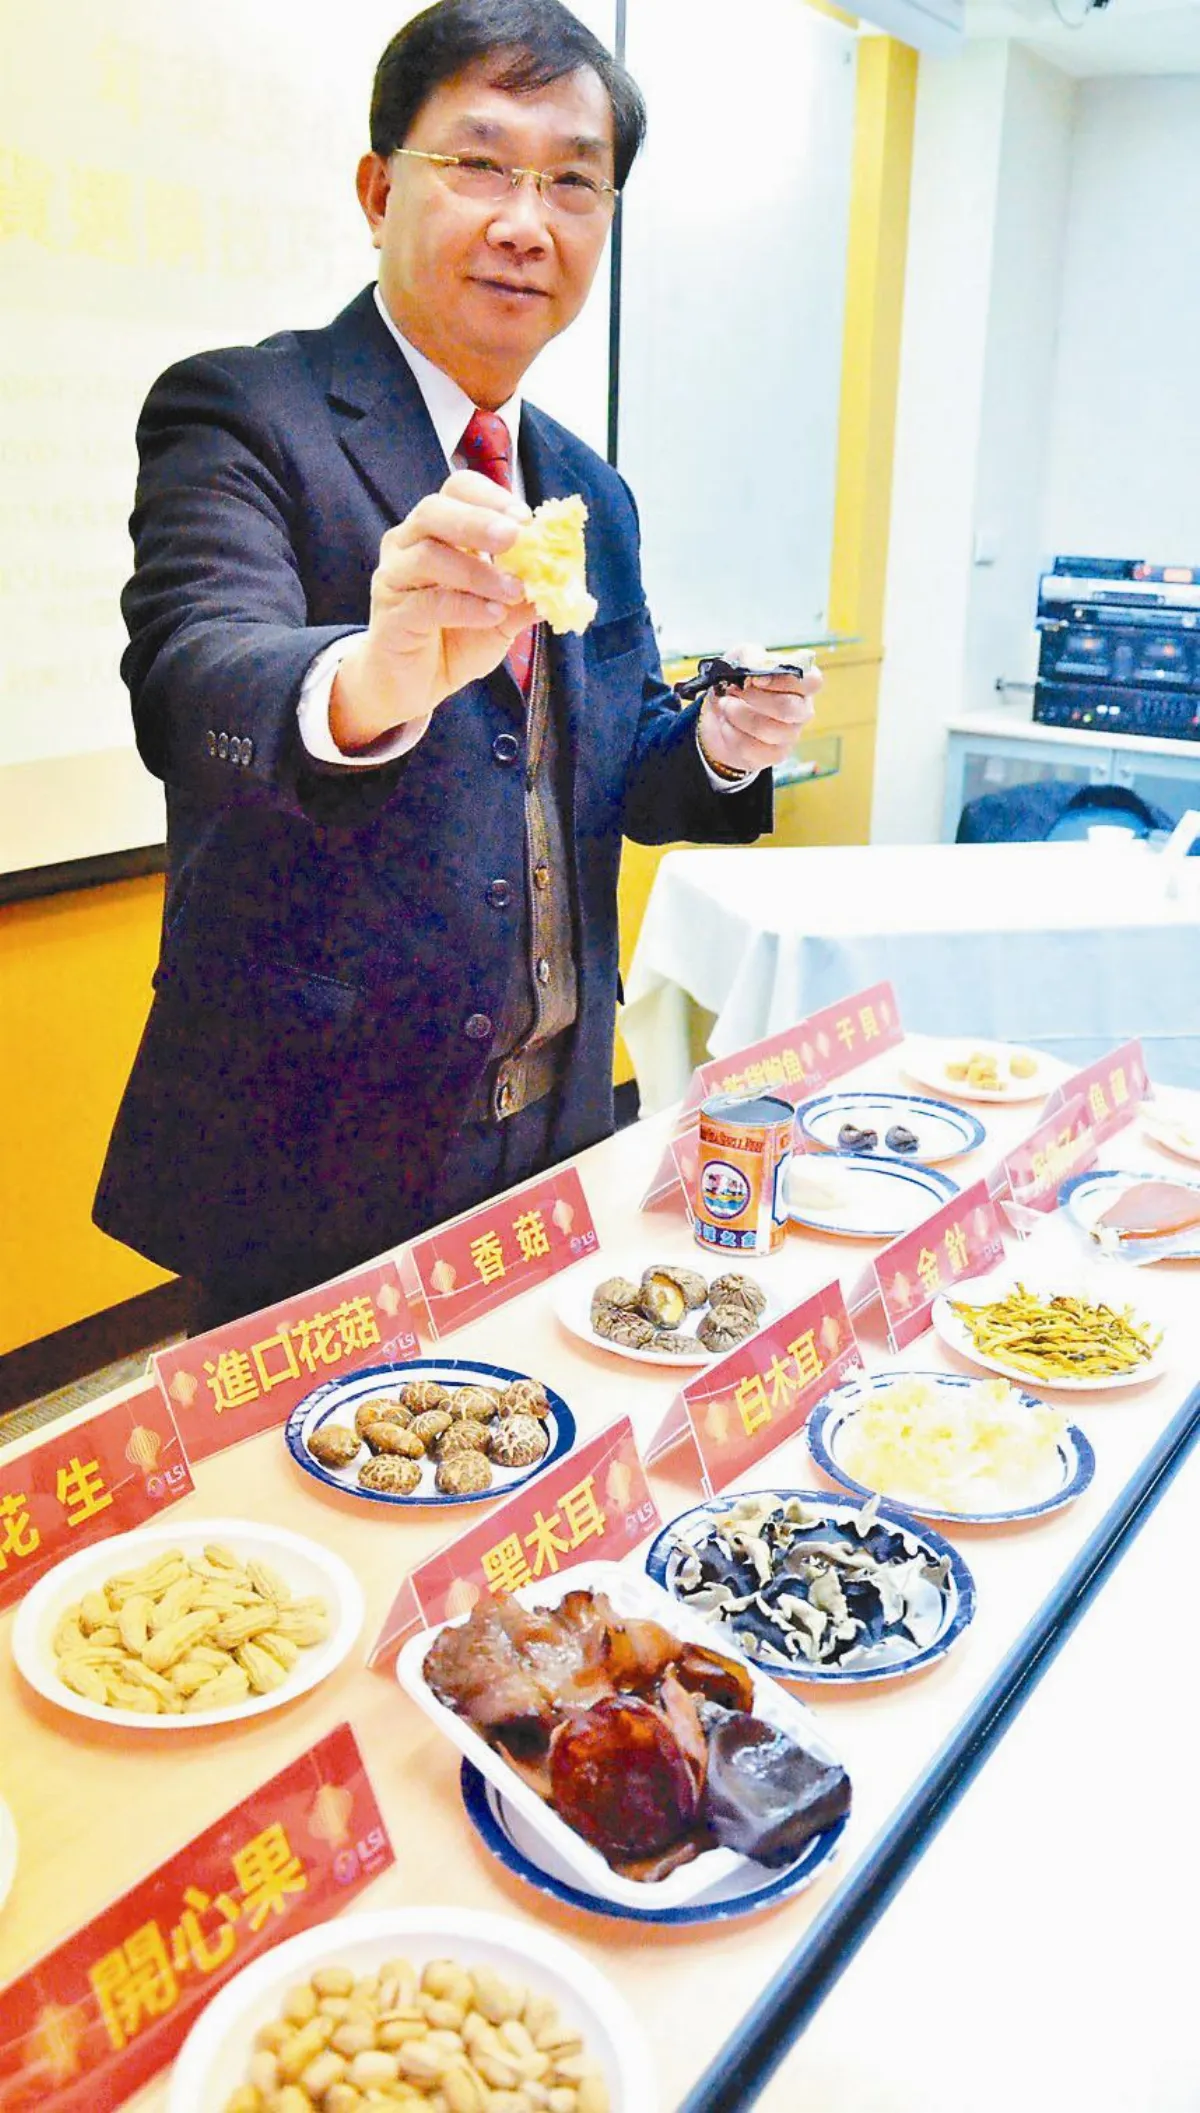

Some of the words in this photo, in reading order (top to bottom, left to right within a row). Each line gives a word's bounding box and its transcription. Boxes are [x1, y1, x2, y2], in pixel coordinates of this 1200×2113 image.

[835, 1005, 881, 1051] 干貝
[470, 1210, 550, 1285] 香菇
[917, 1221, 969, 1299] 金針
[203, 1296, 381, 1413] 進口花菇
[734, 1328, 825, 1435] 白木耳
[0, 1457, 114, 1571] 花生
[480, 1475, 606, 1592] 黑木耳
[88, 1821, 308, 2051] 開心果
